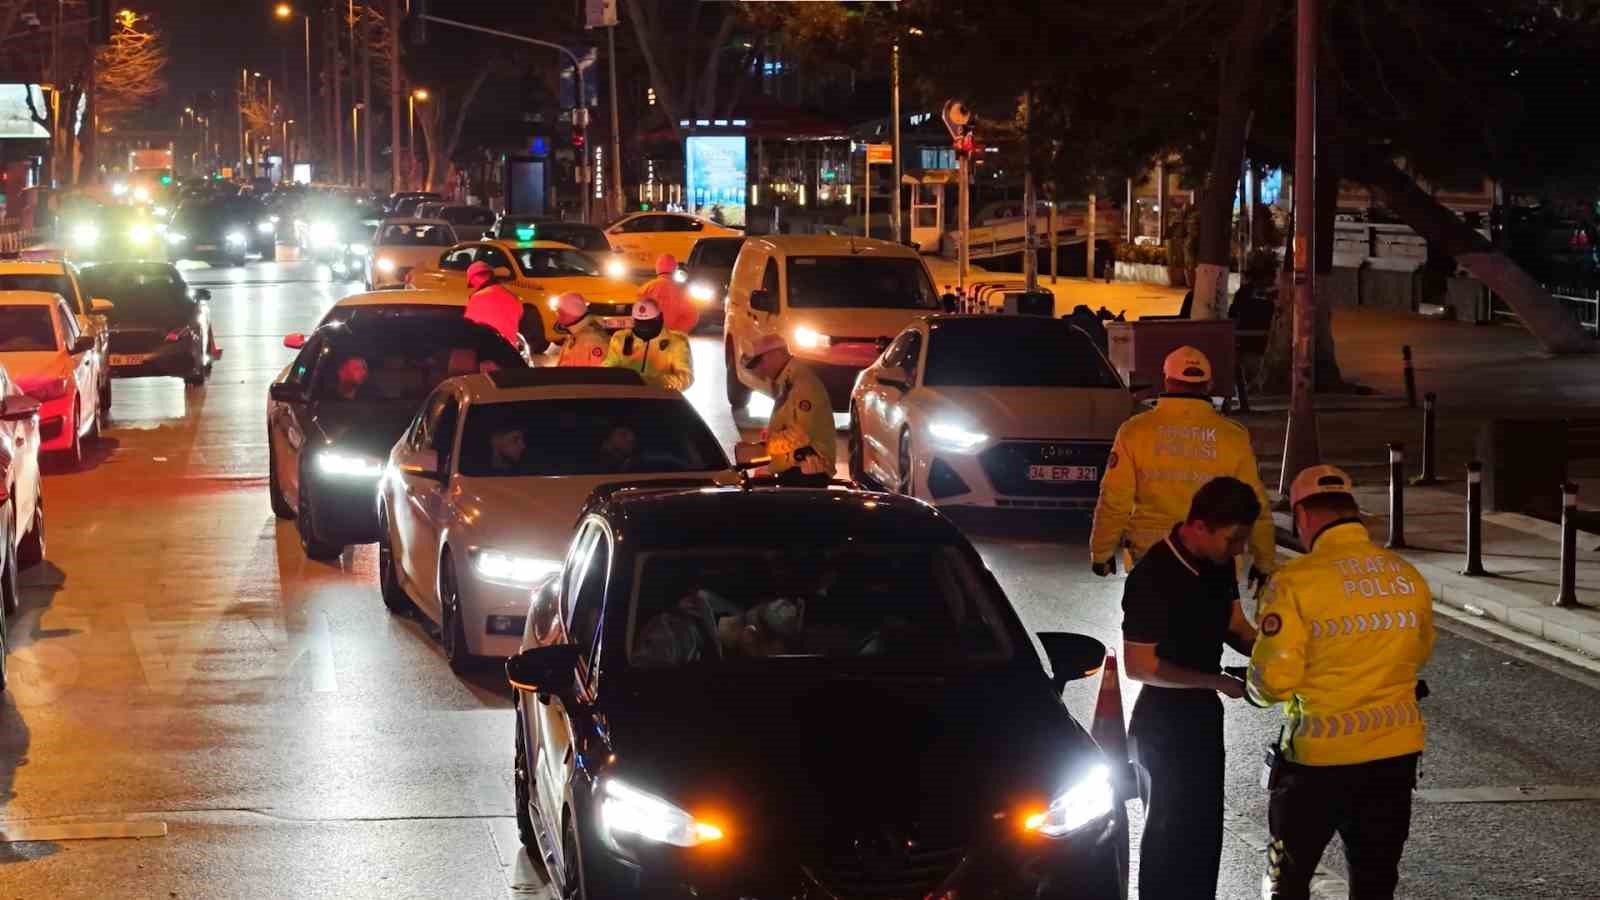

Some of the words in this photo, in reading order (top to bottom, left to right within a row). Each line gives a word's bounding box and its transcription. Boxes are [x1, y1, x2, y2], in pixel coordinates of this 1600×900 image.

[1030, 466, 1047, 480] 34
[1052, 466, 1070, 480] ER
[1078, 467, 1098, 480] 321
